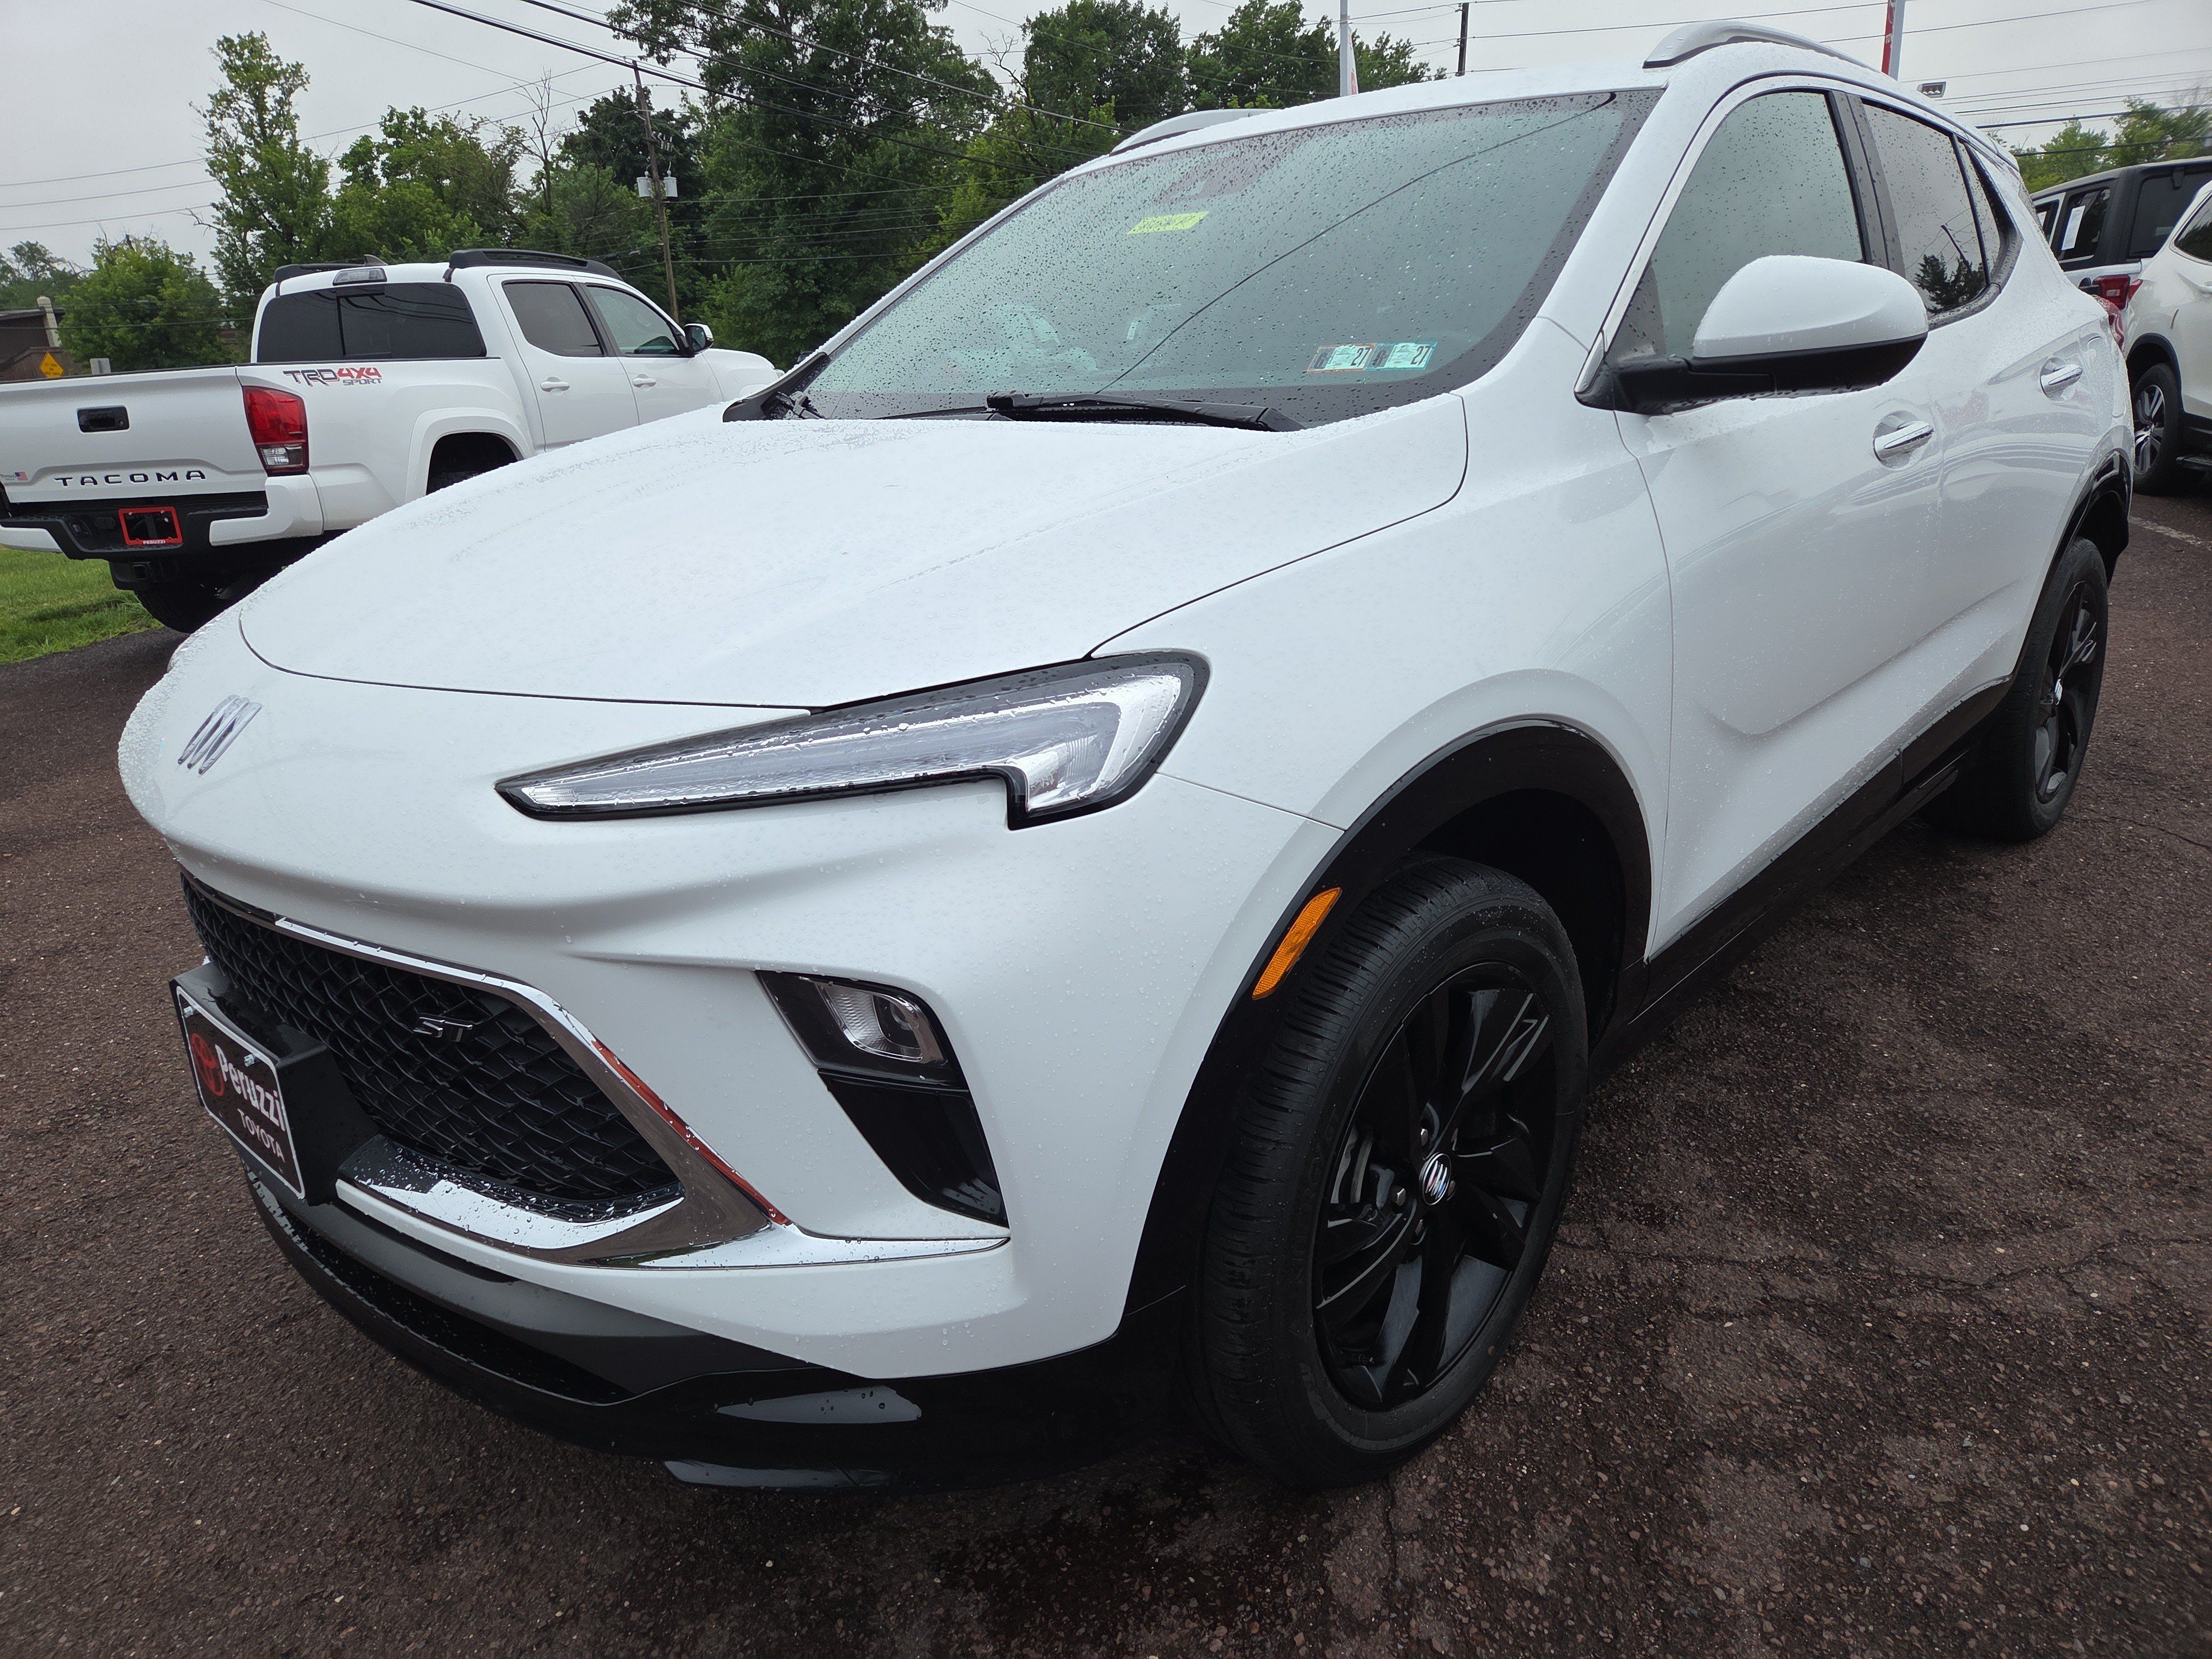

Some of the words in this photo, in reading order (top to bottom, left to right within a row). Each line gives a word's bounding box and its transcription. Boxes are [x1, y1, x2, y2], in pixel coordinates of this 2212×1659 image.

[1350, 347, 1372, 367] 27
[1410, 345, 1431, 366] 27
[342, 377, 383, 386] SPORT
[54, 470, 206, 486] TACOMA
[413, 1016, 473, 1043] ST
[215, 1044, 286, 1131] Peruzzi
[237, 1108, 286, 1163] TOYOTA
